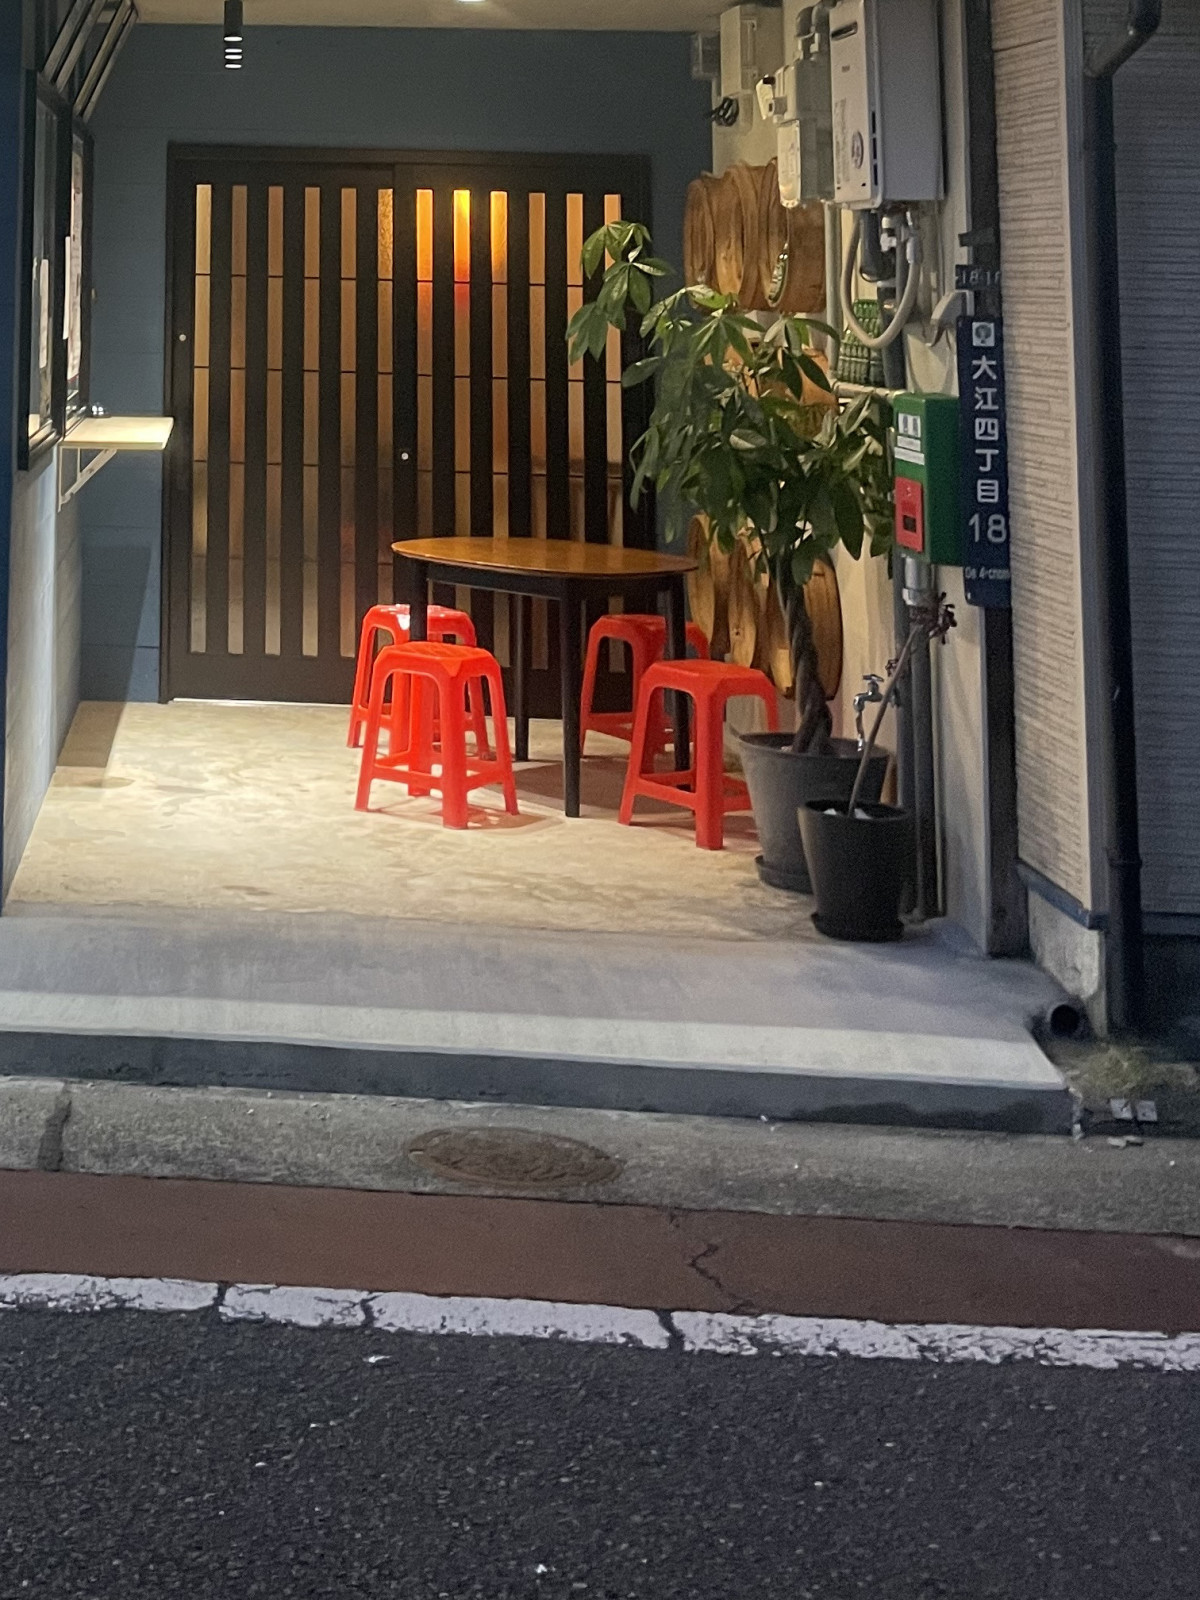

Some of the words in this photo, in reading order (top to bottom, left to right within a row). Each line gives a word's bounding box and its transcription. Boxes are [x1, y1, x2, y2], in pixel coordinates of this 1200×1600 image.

[971, 354, 999, 505] 大江四丁目
[968, 512, 1007, 544] 18
